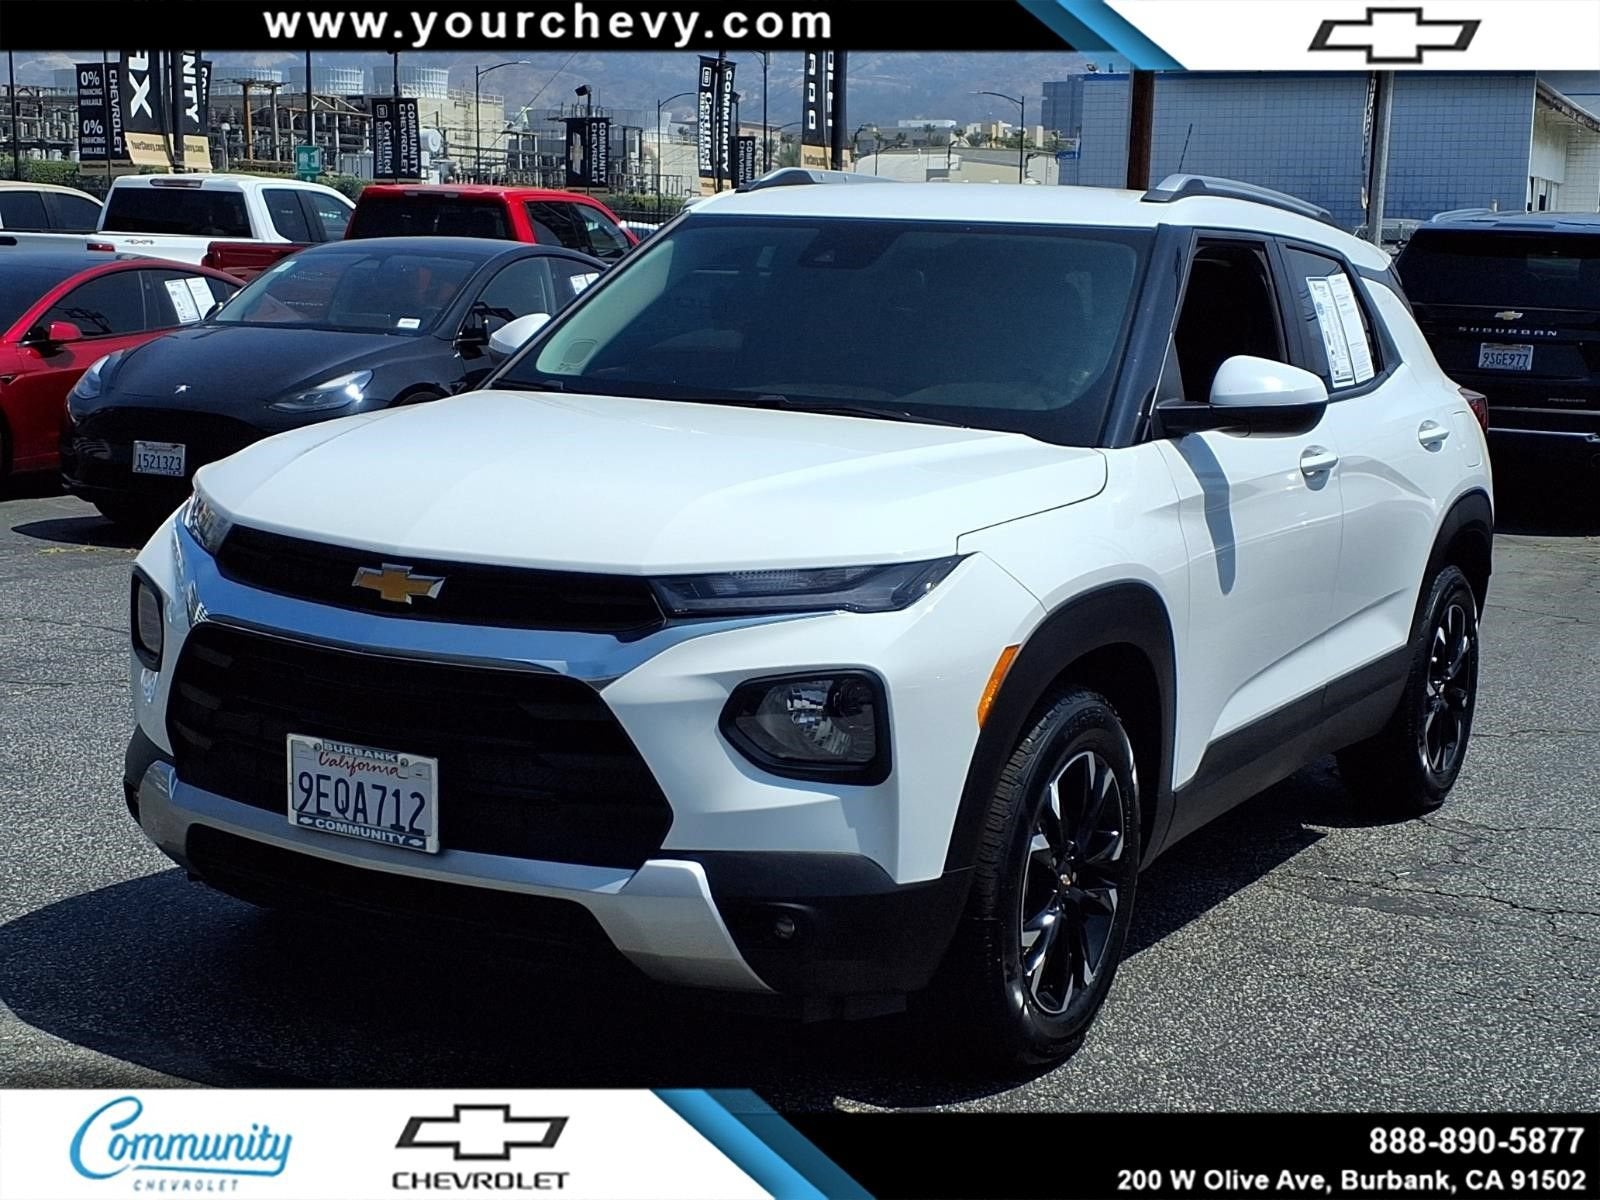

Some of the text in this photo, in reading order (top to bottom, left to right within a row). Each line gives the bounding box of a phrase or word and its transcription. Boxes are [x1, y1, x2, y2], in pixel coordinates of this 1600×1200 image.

[80, 71, 100, 86] 0%
[108, 69, 122, 154] CHEVROLET
[721, 69, 732, 172] COMMUNITY
[83, 119, 103, 134] 0%
[399, 103, 408, 174] CHEVROLET
[407, 103, 418, 173] COMMUNITY
[383, 121, 393, 174] Certified
[591, 122, 599, 184] CHEVROLET
[1458, 326, 1558, 336] SUBURBAN
[1482, 352, 1529, 367] 9SGE977
[137, 453, 182, 471] 1521323
[318, 751, 409, 780] California
[323, 743, 399, 763] BURBANK
[298, 771, 426, 836] 9EQA712
[315, 818, 407, 846] COMMUNITY
